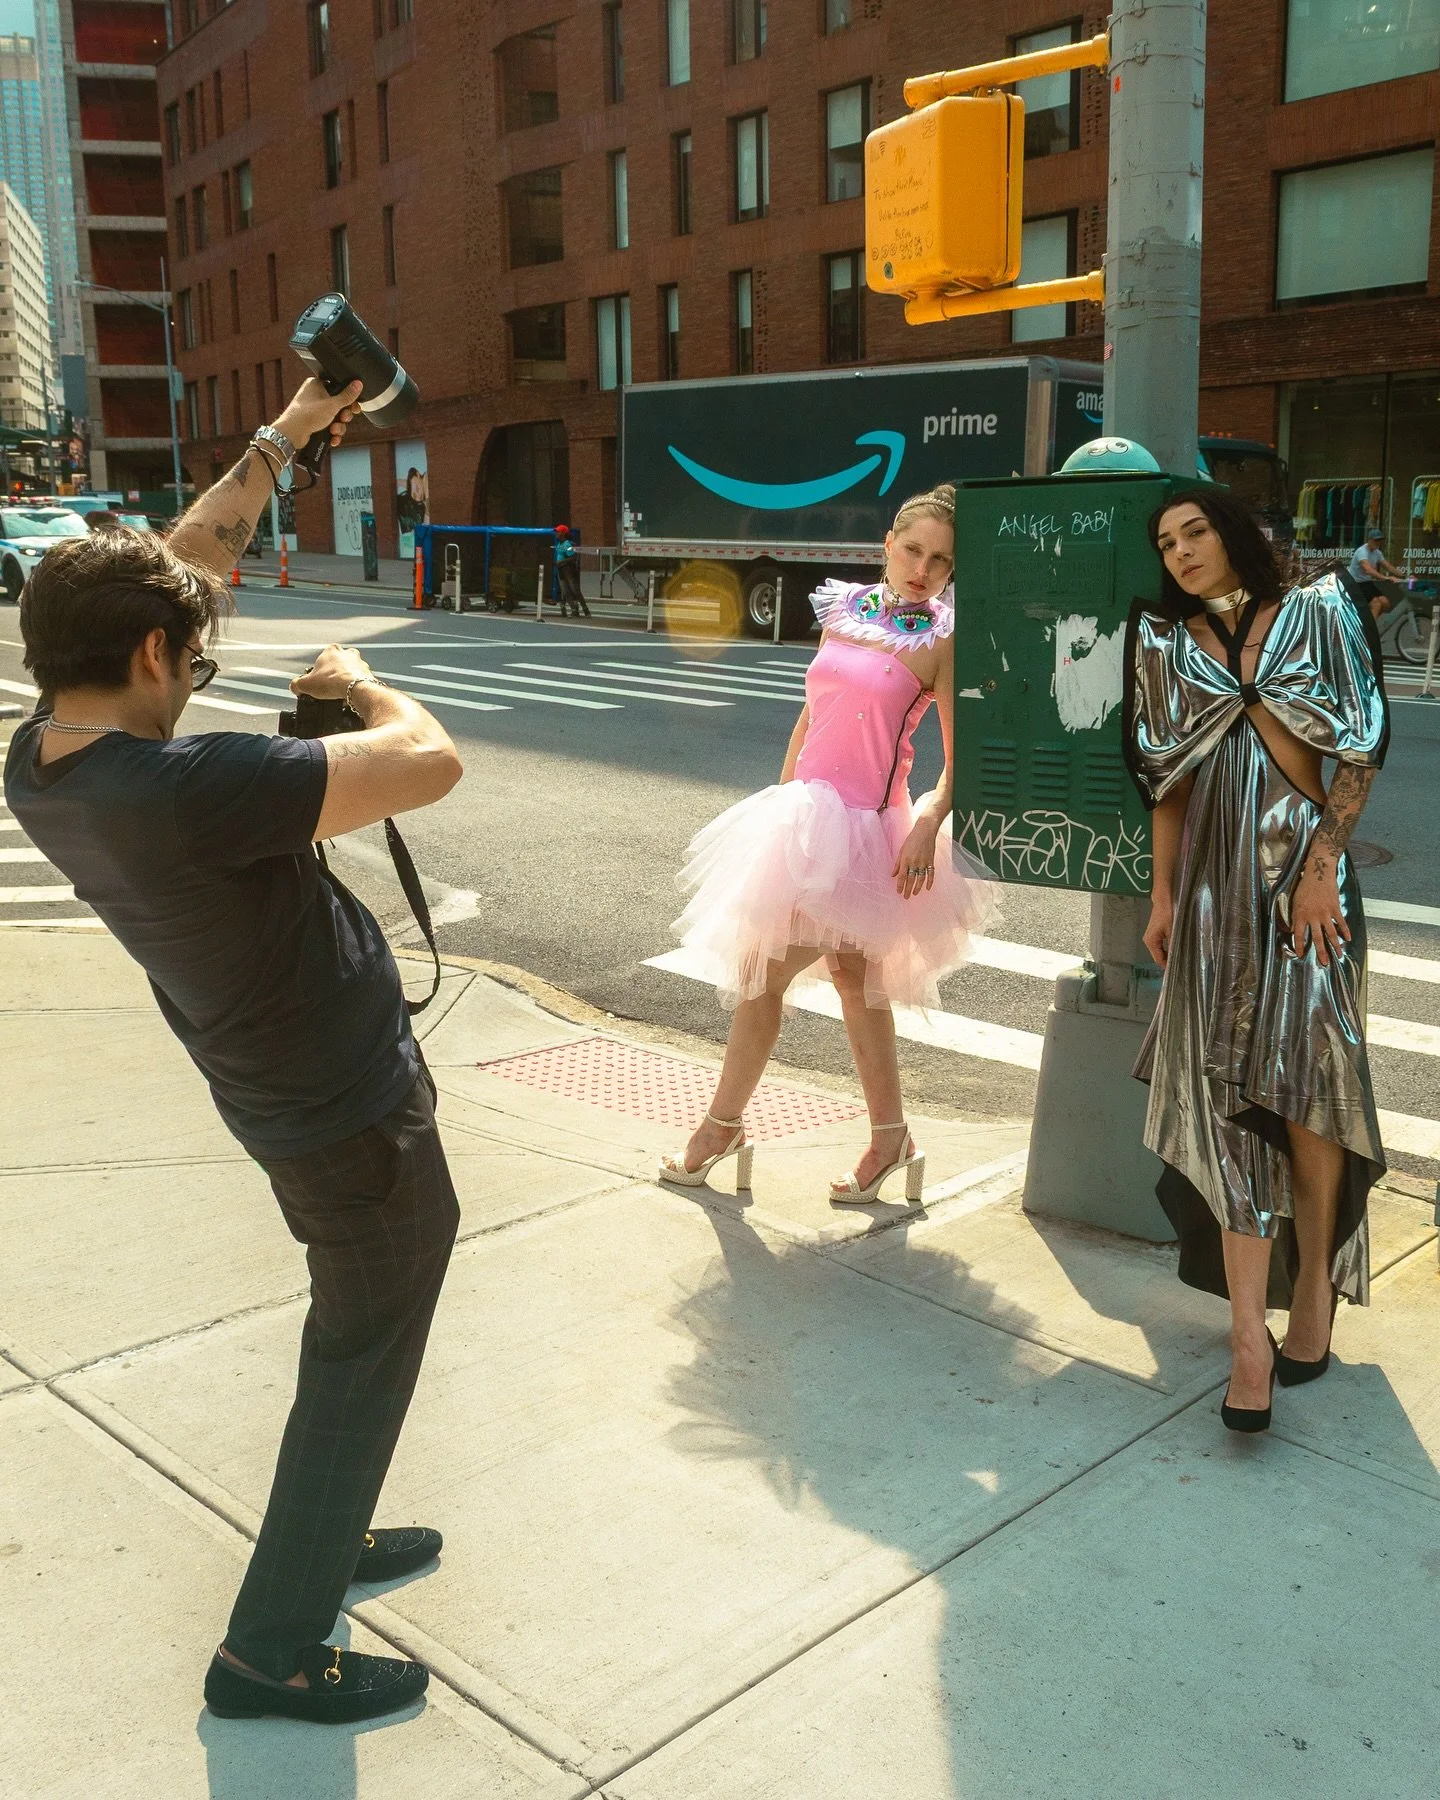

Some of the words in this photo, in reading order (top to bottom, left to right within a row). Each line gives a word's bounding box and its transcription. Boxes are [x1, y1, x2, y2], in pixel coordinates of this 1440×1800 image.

[923, 407, 998, 443] prime
[998, 513, 1063, 537] ANGEL
[1071, 506, 1115, 542] BABY
[1414, 566, 1427, 574] OFF
